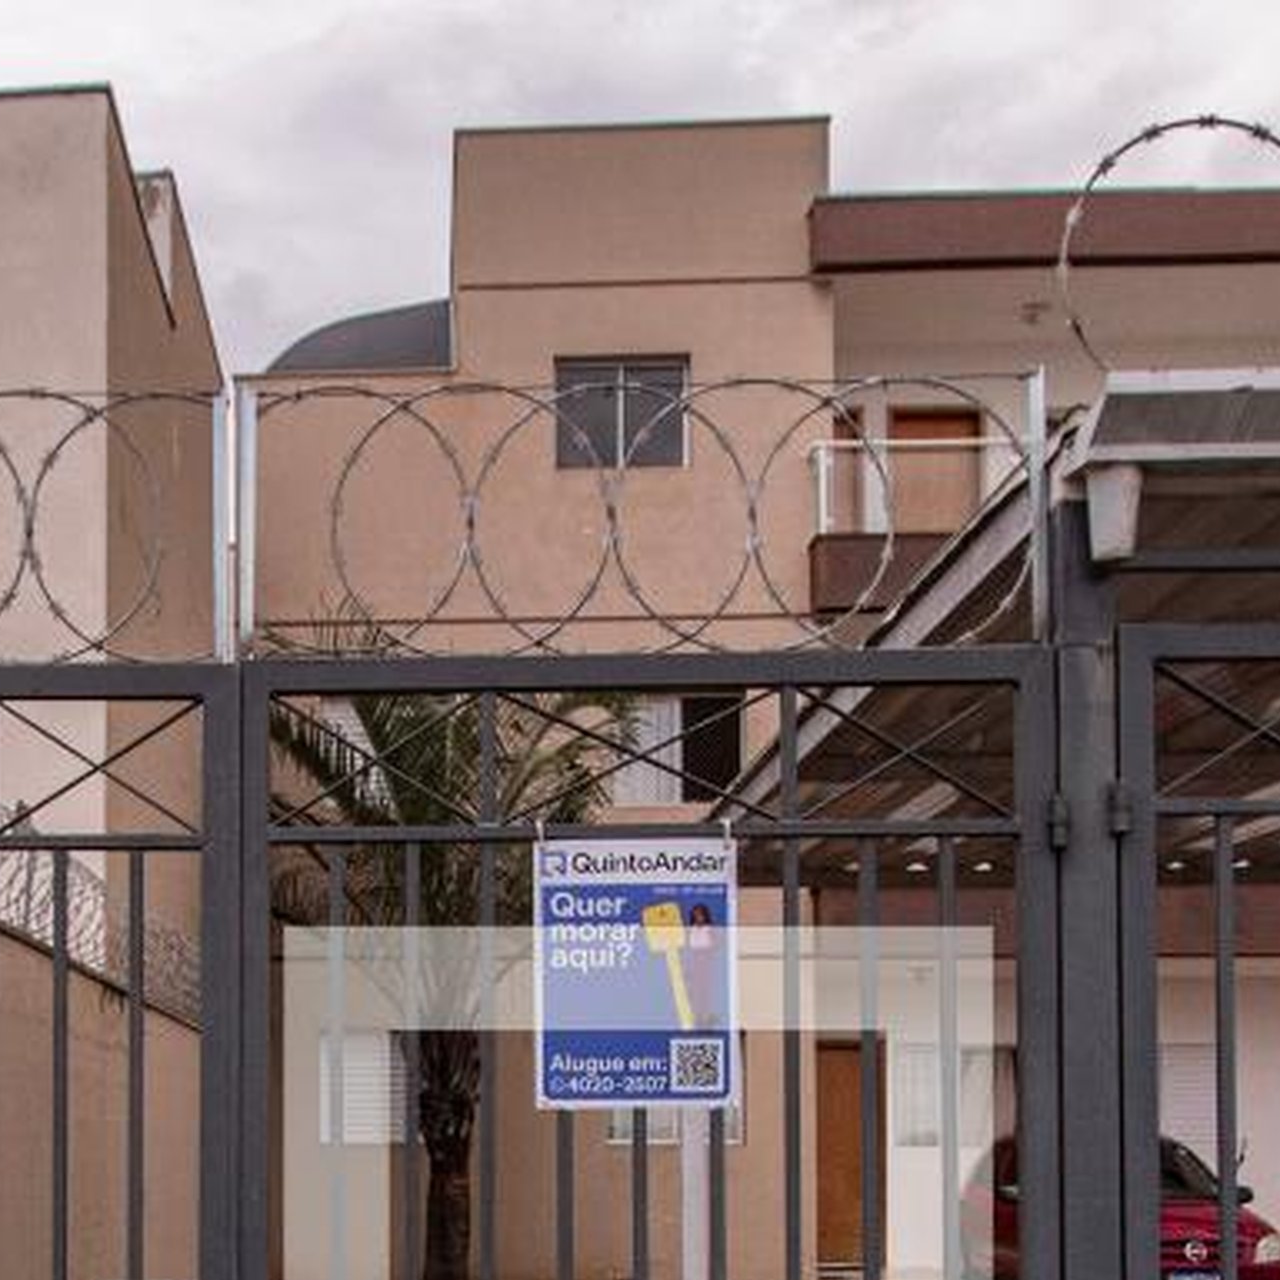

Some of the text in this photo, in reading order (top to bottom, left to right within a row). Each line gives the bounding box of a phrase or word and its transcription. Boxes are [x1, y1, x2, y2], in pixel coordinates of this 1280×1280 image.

[571, 852, 726, 875] QuintoAndar
[549, 893, 625, 918] Quer
[550, 923, 639, 943] morar
[550, 943, 633, 974] aqui?
[549, 1053, 668, 1077] Alugue em:
